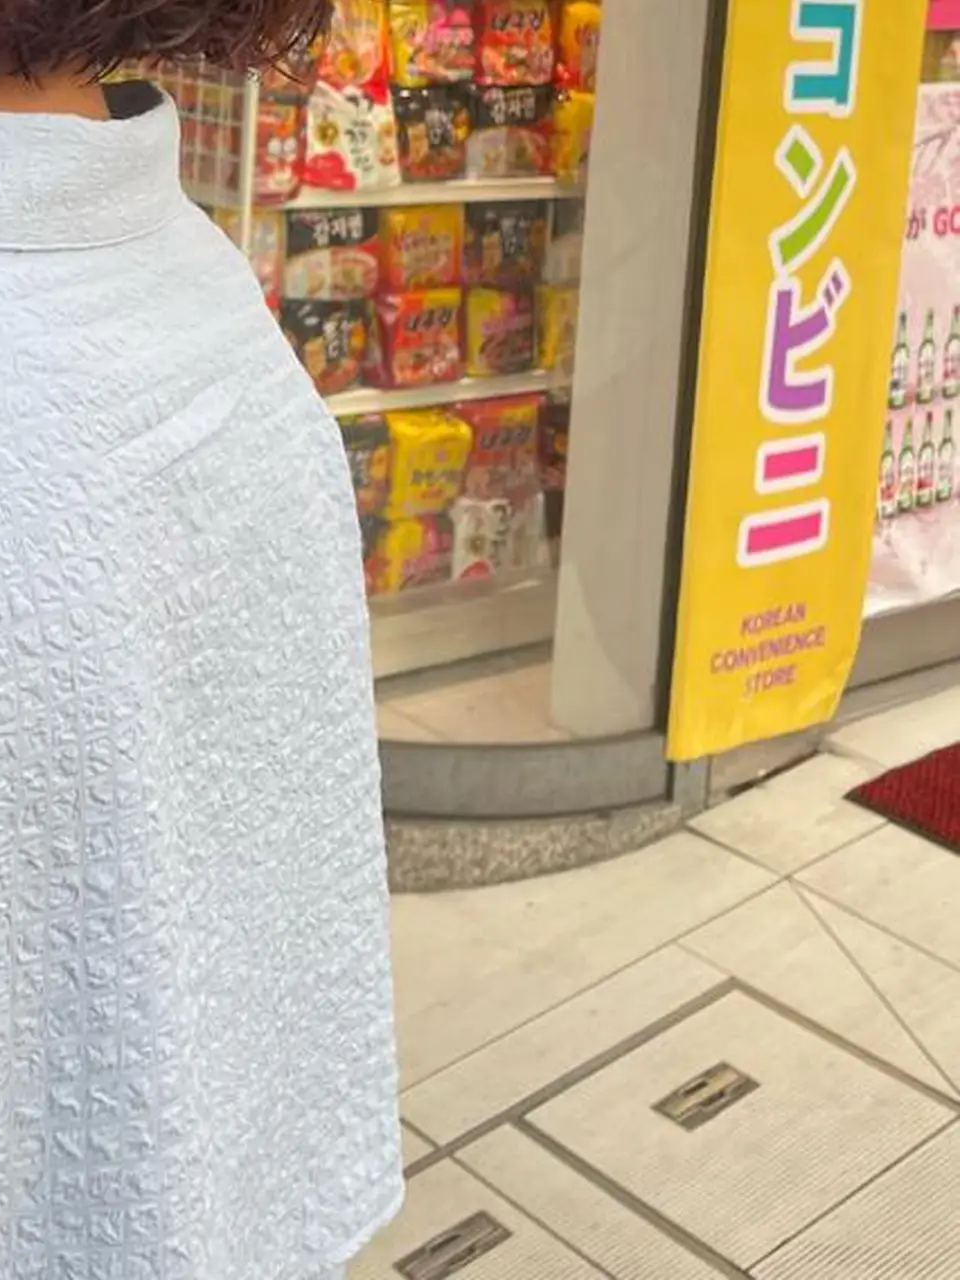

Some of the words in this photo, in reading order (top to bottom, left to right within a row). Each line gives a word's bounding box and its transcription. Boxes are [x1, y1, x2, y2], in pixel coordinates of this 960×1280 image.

[740, 600, 807, 637] KOREAN
[710, 624, 826, 676] CONVENIENCE
[742, 663, 798, 700] STORE
